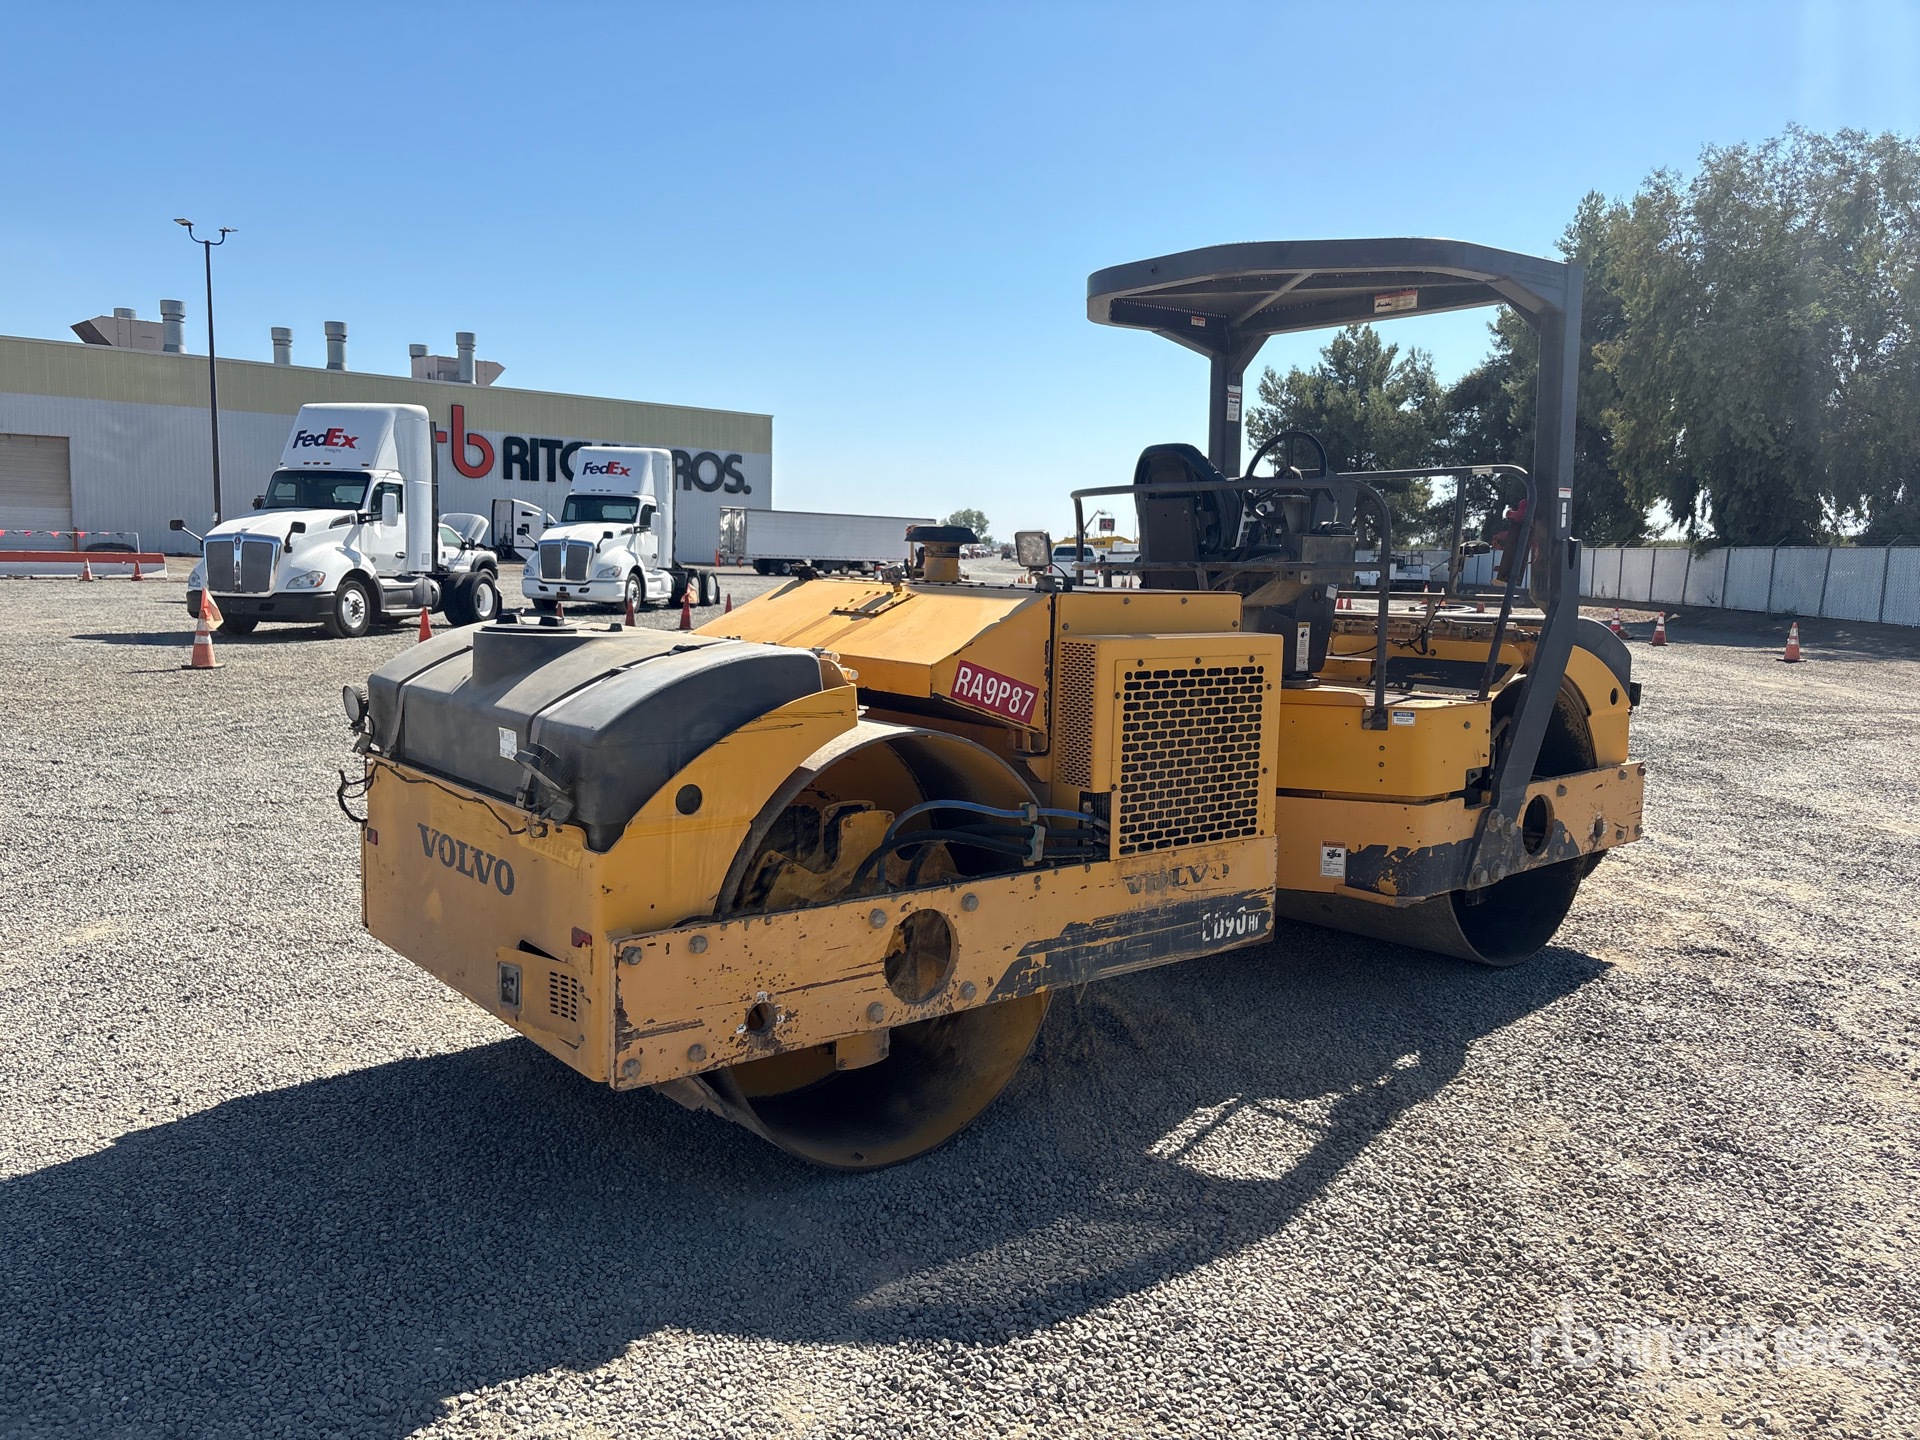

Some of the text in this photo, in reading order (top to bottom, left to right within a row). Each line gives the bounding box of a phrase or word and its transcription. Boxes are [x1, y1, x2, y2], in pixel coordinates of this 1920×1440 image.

[292, 428, 360, 449] FedEx
[582, 461, 631, 477] FedEx
[672, 449, 752, 495] ROS.
[954, 666, 1035, 717] RA9P87
[416, 822, 515, 896] VOLVO
